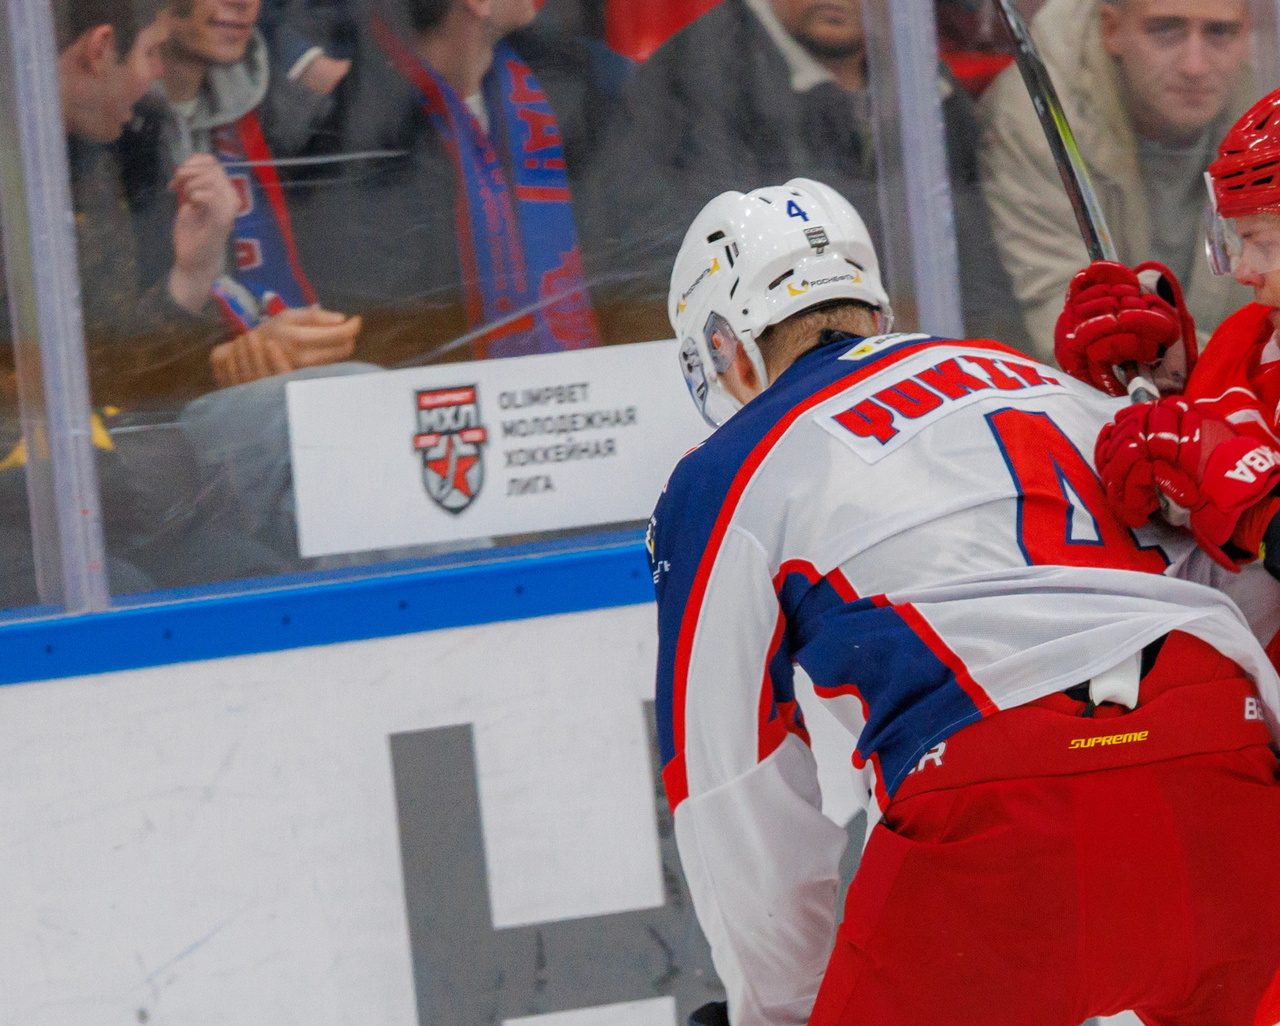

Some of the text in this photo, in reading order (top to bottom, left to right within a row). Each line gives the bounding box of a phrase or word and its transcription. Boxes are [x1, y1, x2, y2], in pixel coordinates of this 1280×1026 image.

[786, 199, 809, 222] 4
[498, 382, 590, 410] OLIMPBET
[502, 405, 637, 438] МОЛОДЕЖНАЯ
[504, 437, 617, 468] ХОККЕЙНАЯ
[506, 475, 554, 498] ЛИГА
[983, 407, 1173, 576] 4
[1068, 730, 1149, 750] SUPREME
